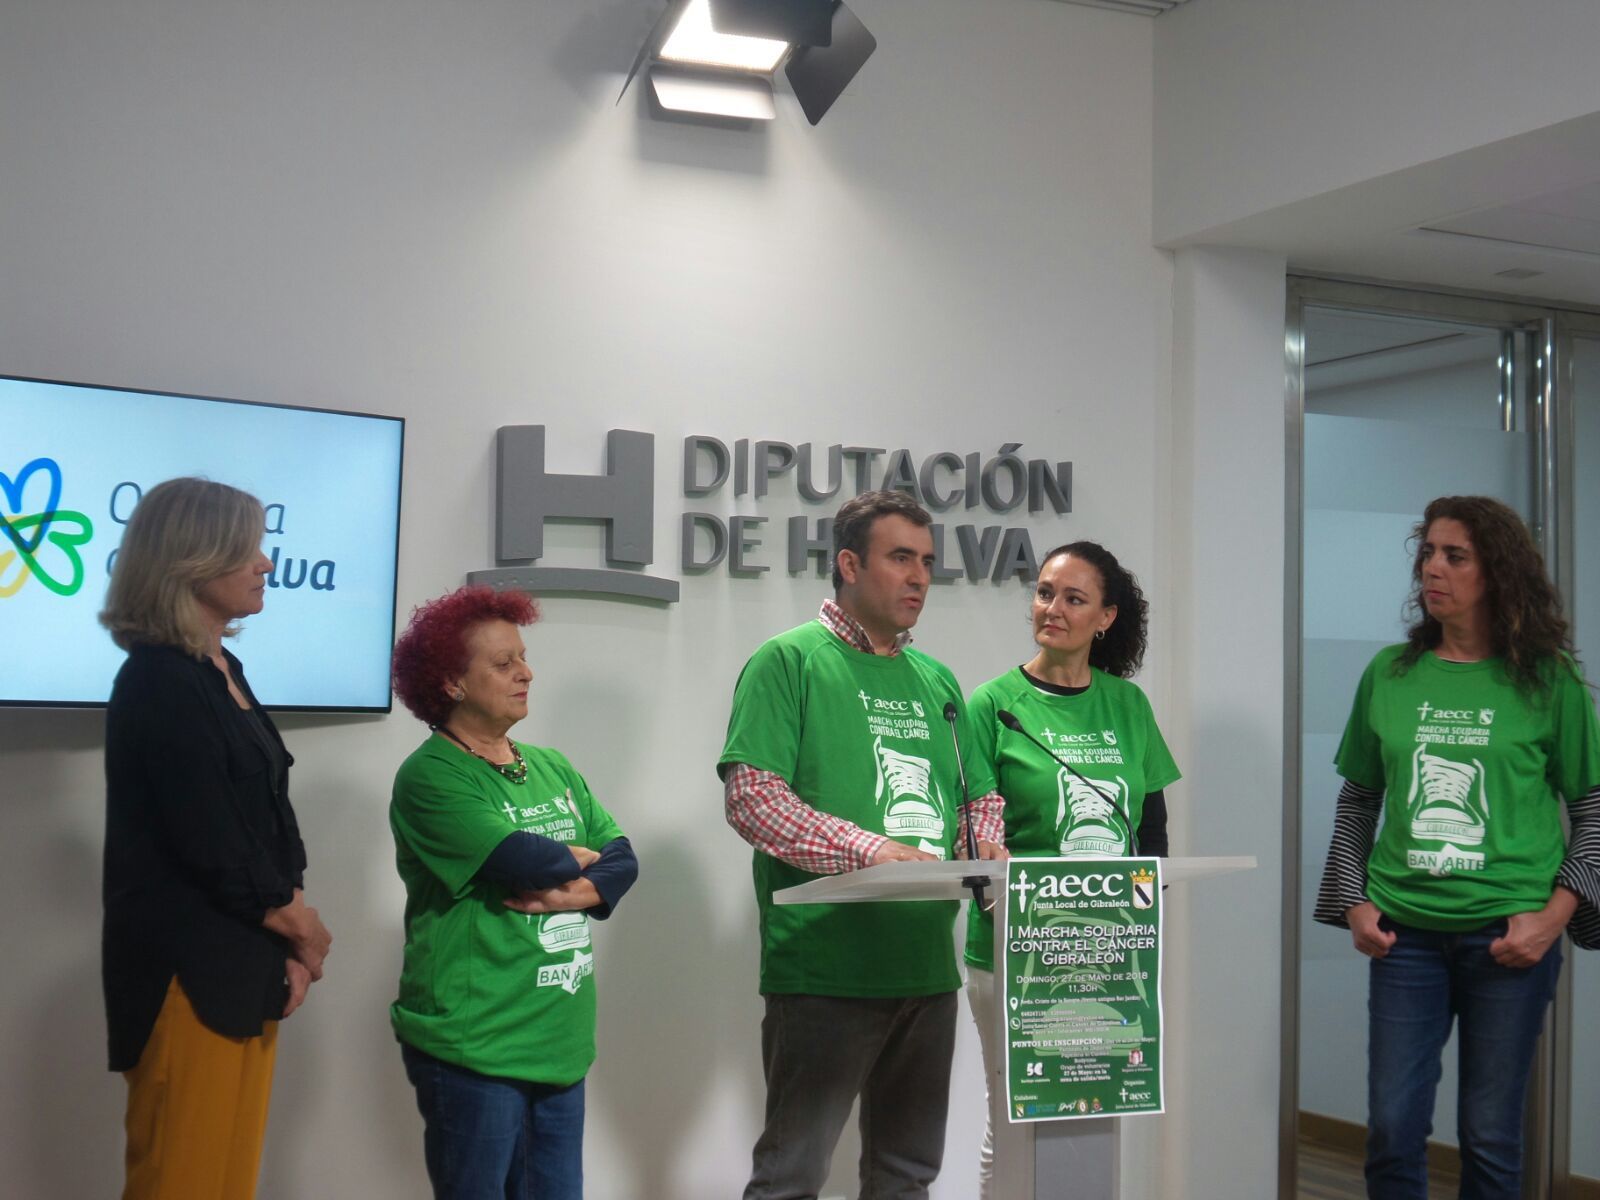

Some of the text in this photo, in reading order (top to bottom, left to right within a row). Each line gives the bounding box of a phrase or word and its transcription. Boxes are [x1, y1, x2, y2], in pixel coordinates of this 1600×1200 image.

[684, 435, 1072, 514] DIPUTACIÓN
[682, 512, 1039, 584] DE HLVA
[874, 699, 908, 710] aecc
[1433, 709, 1474, 720] aecc
[868, 716, 928, 730] MARCHA SOLIDARIA
[870, 724, 895, 737] CONTRA
[1417, 725, 1490, 736] MARCHA SOLIDARIA
[1060, 733, 1098, 742] aecc
[1415, 734, 1446, 744] CONTRA
[1052, 748, 1120, 756] MARCHA SOLIDARIA
[520, 804, 552, 818] aecc
[1039, 874, 1124, 898] aecc
[1034, 900, 1130, 910] Junta Local de Gibraleón
[1010, 924, 1157, 939] I MARCHA SOLIDARIA
[1010, 940, 1070, 952] CONTRA
[1074, 941, 1092, 951] EL
[1062, 974, 1072, 982] 27
[1088, 973, 1111, 982] MAYO
[1126, 972, 1148, 980] 2018
